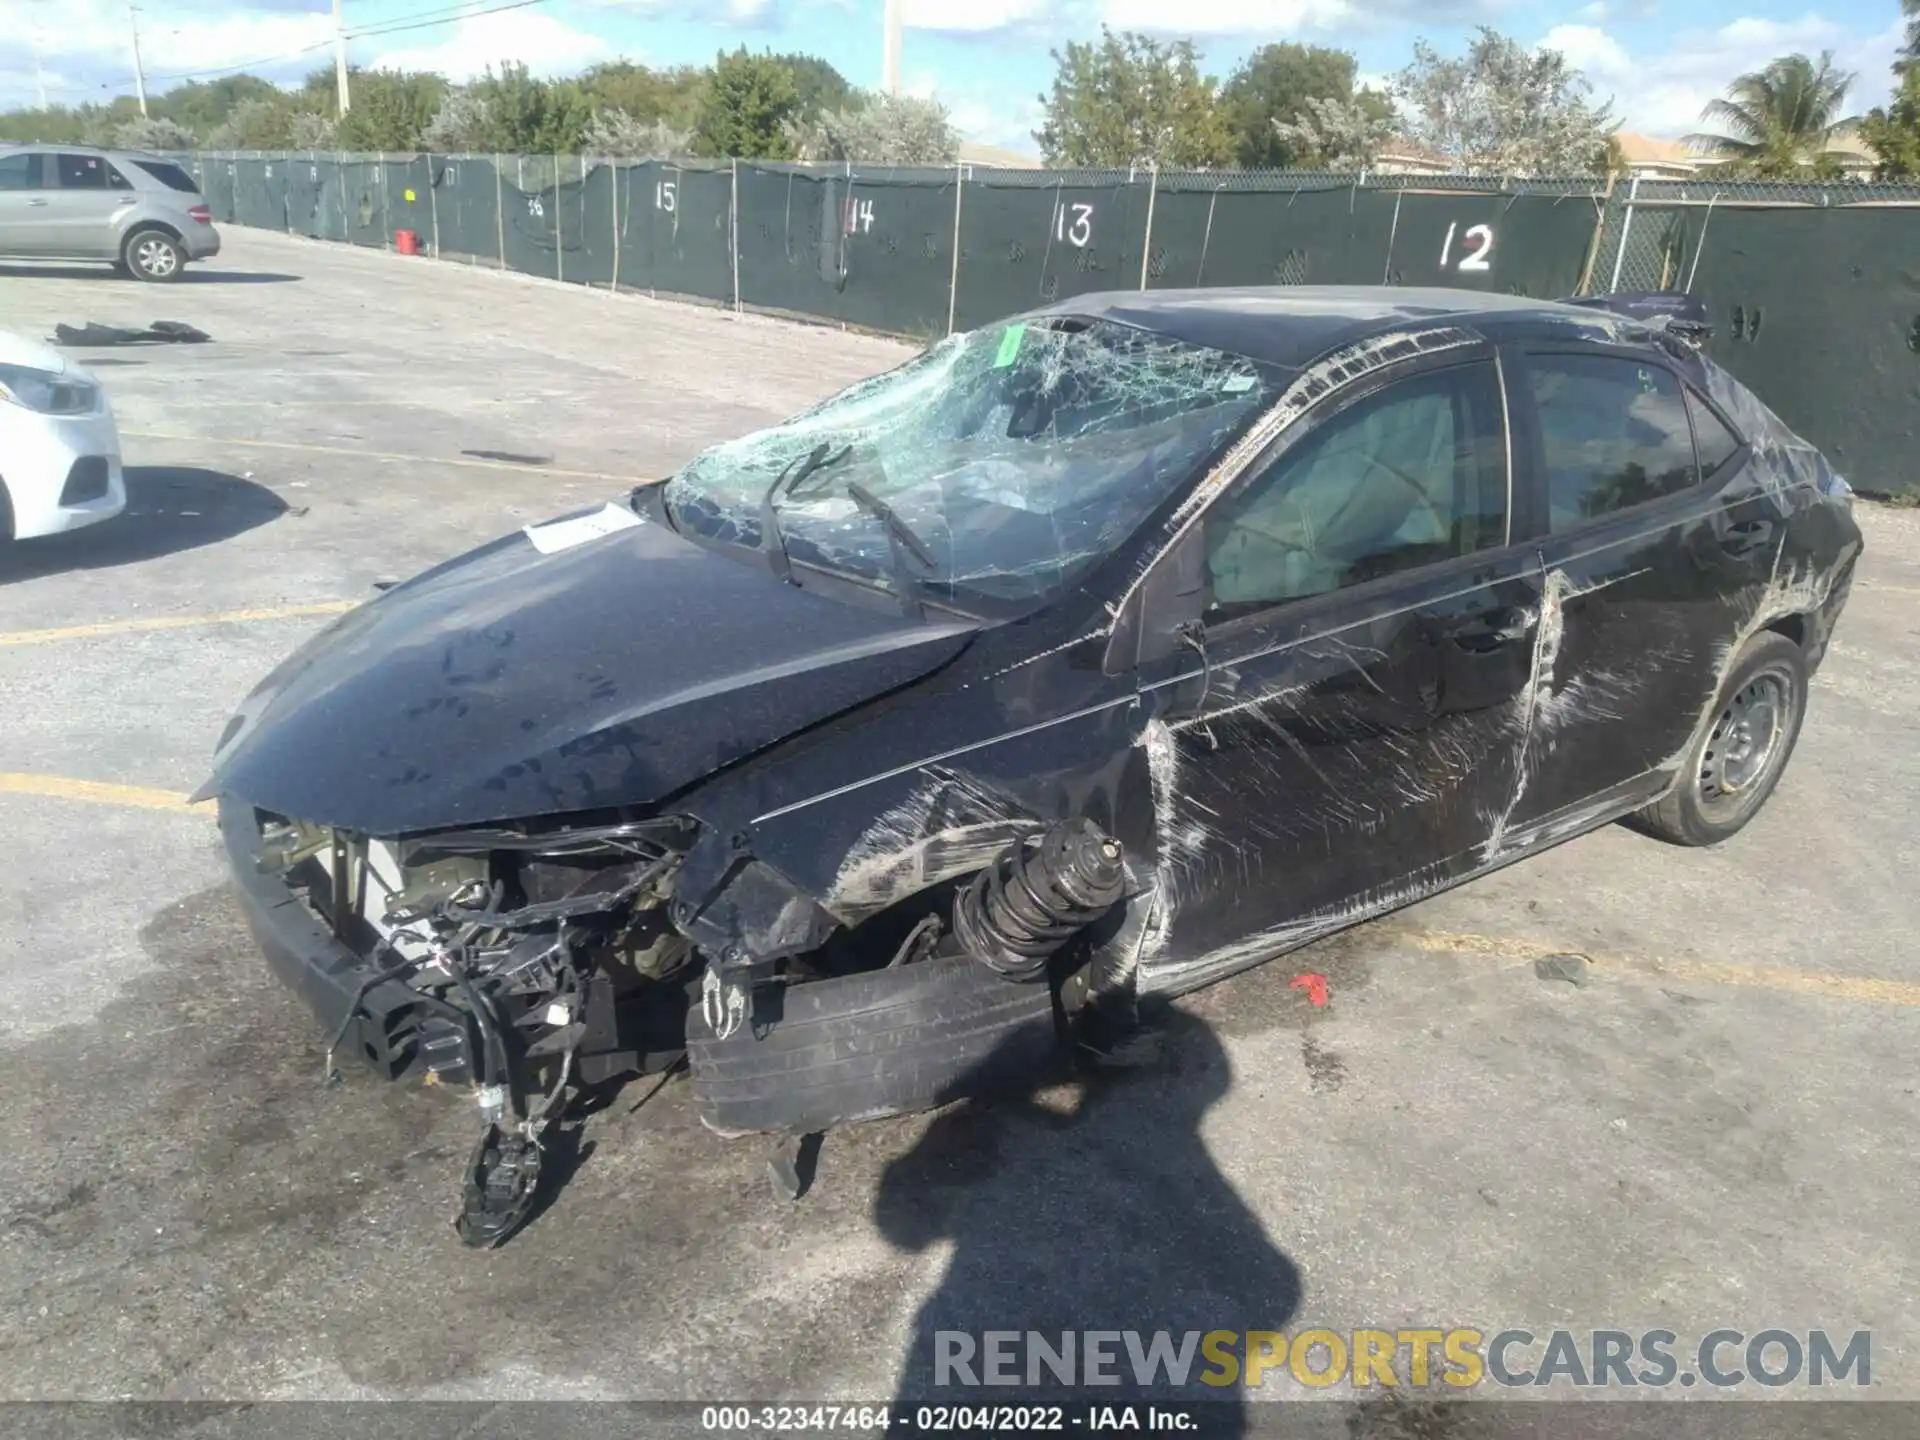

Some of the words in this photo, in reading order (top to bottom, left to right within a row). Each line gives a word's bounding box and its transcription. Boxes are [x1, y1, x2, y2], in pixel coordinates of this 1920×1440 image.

[656, 181, 676, 211] 15
[851, 198, 874, 233] 14
[1058, 203, 1093, 247] 13
[1441, 222, 1492, 270] 12
